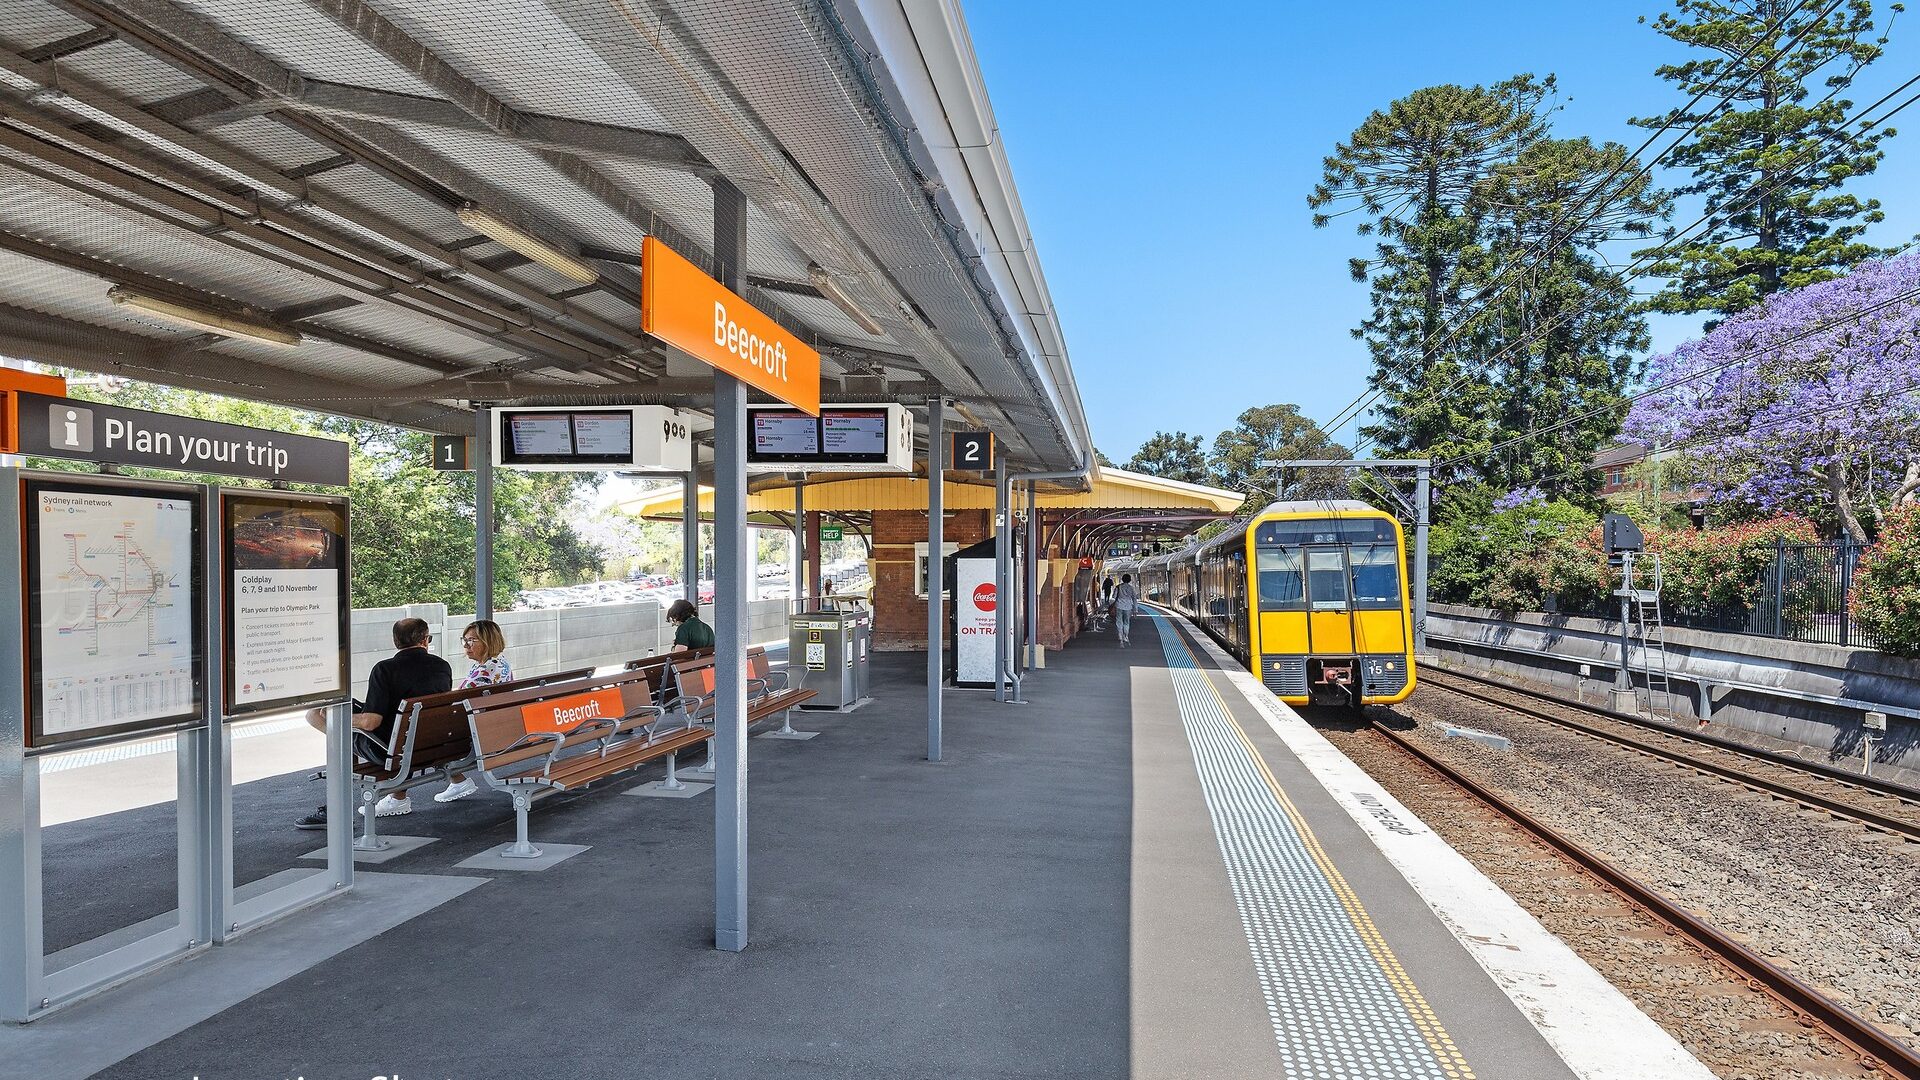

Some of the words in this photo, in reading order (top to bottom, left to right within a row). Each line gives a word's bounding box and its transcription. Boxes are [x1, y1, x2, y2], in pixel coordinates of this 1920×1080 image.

[714, 301, 788, 382] Beecroft
[106, 418, 171, 454] Plan
[179, 436, 240, 464] your
[246, 440, 288, 474] trip
[445, 444, 454, 462] 1
[965, 441, 979, 461] 2
[44, 496, 71, 505] Sydney
[241, 576, 272, 584] Coldplay
[553, 700, 601, 725] Beecroft
